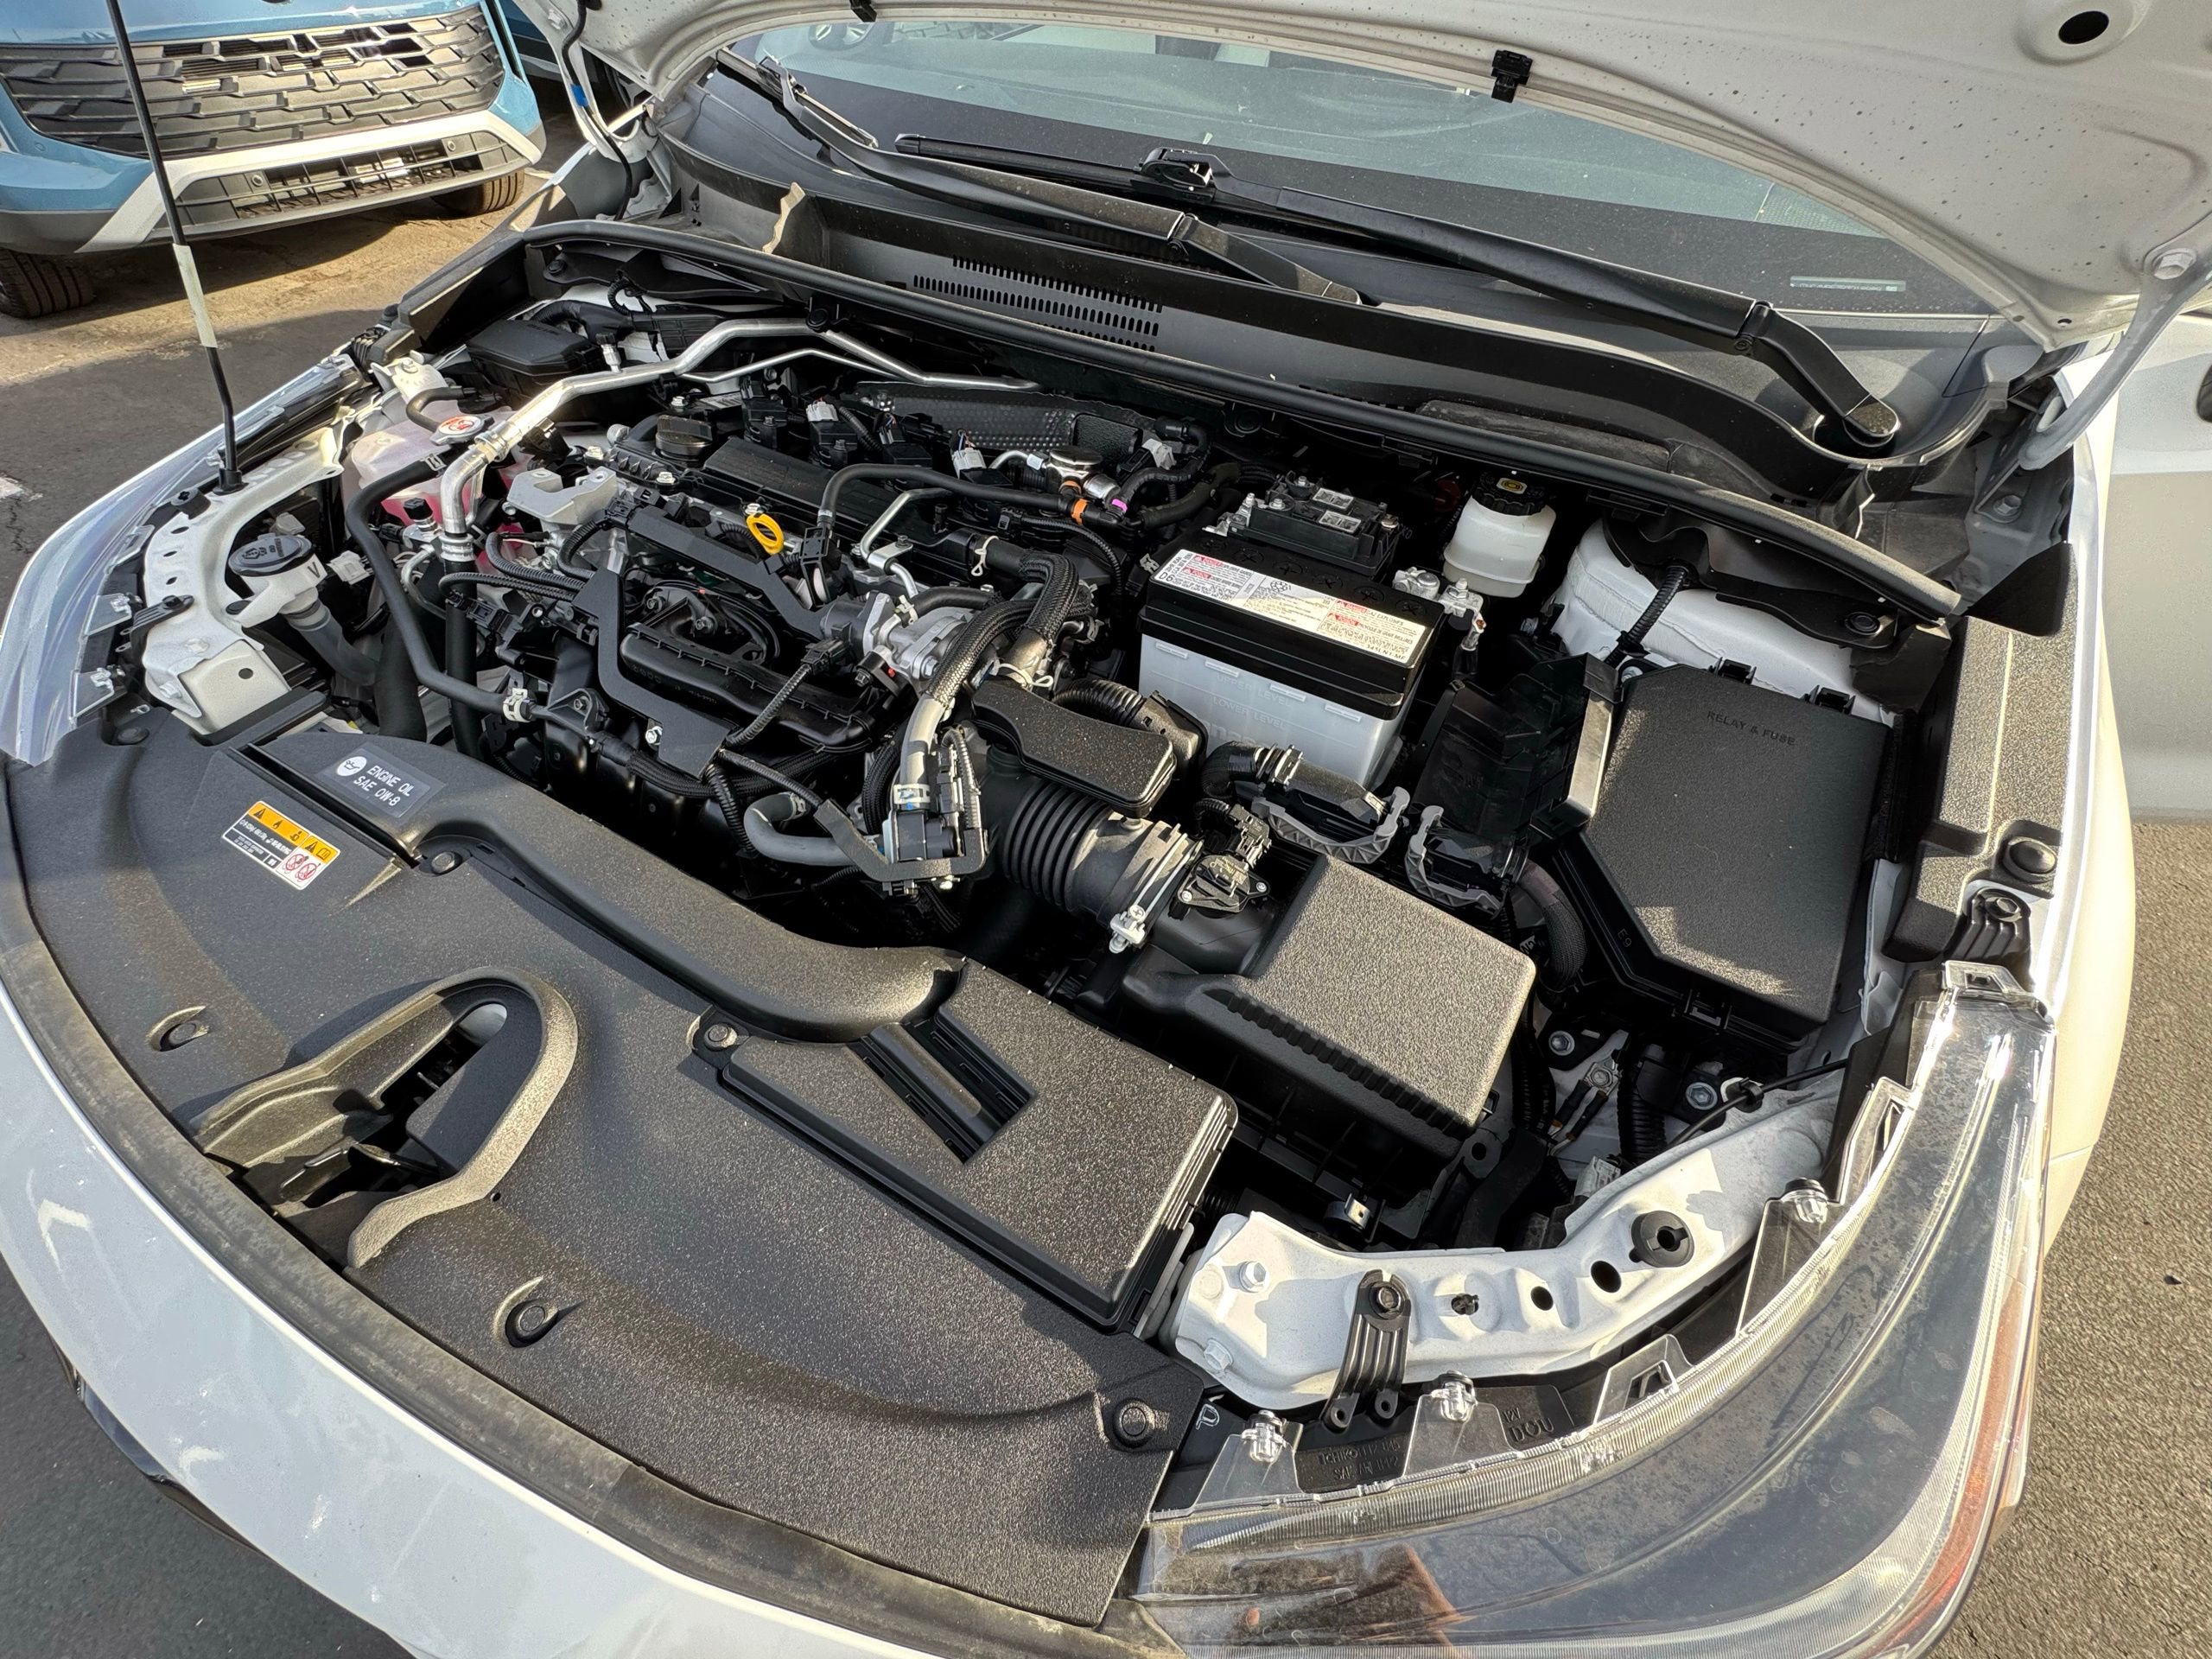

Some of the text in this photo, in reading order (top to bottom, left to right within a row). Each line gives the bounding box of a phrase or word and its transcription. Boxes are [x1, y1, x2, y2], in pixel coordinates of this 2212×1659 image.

[1217, 674, 1293, 708] UPPER LEVEL
[1213, 696, 1287, 731] LOWER LEVEL
[1707, 711, 1796, 746] RELAY & FUSE
[353, 776, 378, 791] SAE
[366, 765, 415, 797] ENGINE OIL
